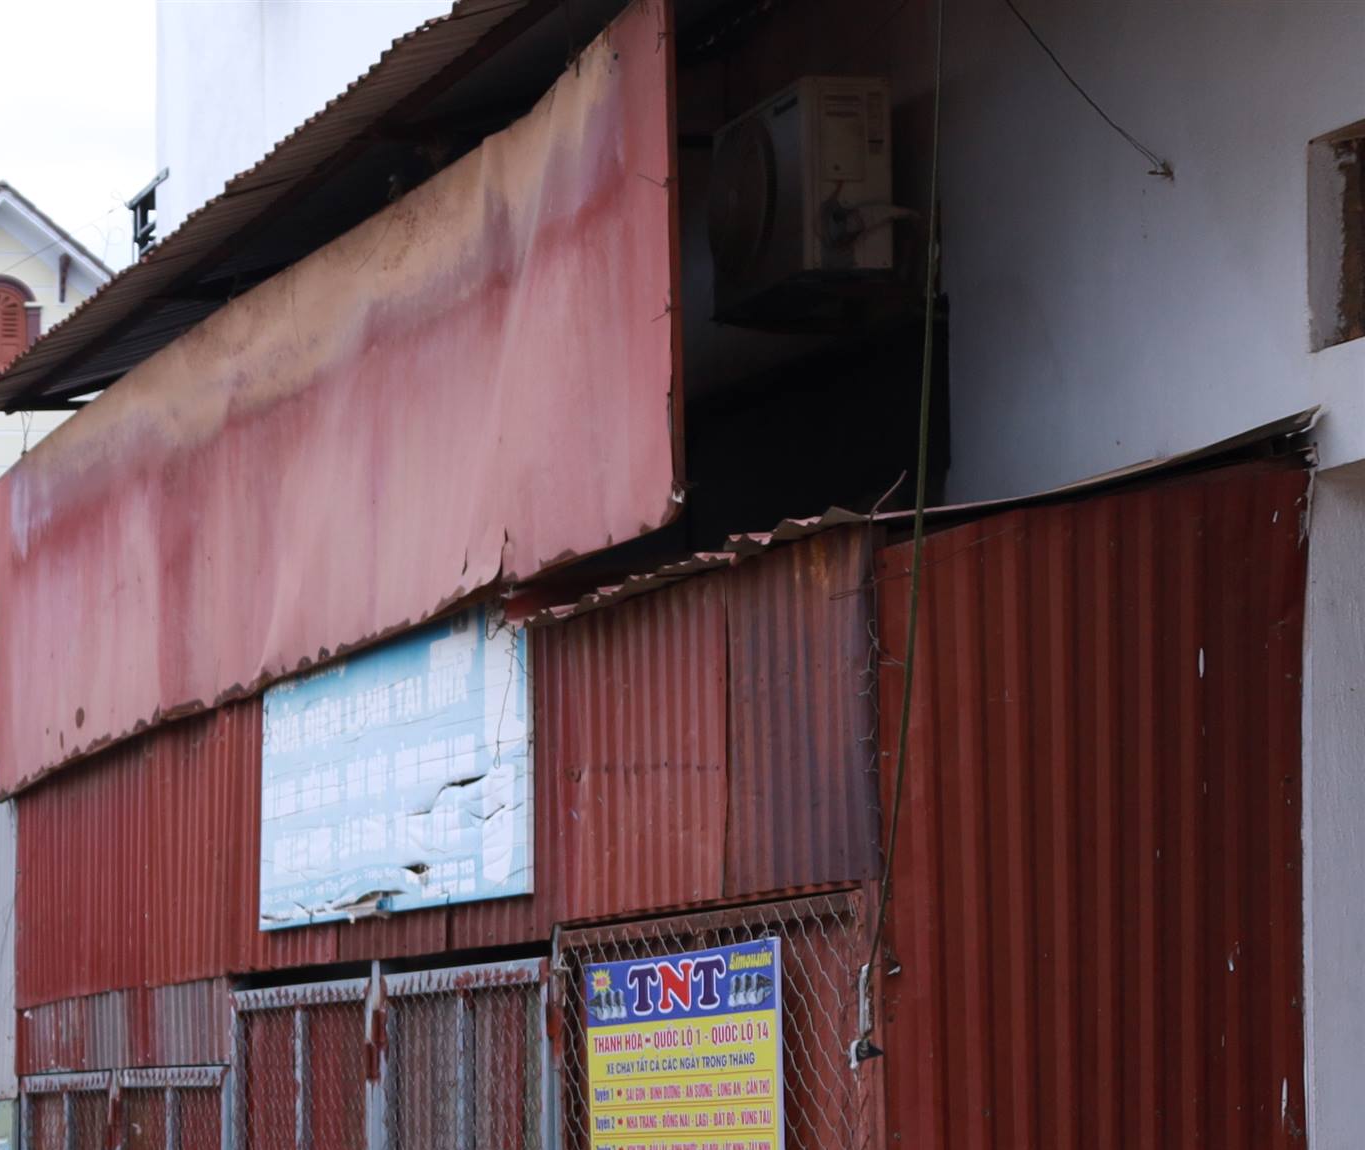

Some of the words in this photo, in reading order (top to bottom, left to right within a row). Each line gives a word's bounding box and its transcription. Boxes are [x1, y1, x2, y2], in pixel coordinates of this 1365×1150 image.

[628, 955, 726, 1016] TNT
[594, 1034, 622, 1054] THANH
[625, 1029, 643, 1051] HÓA
[654, 1022, 679, 1050] QUỐC
[681, 1026, 693, 1050] LỘ
[696, 1029, 701, 1046] 1
[711, 1017, 738, 1046] QUỐC
[741, 1018, 754, 1045] LỘ
[757, 1021, 769, 1040] 14
[607, 1062, 616, 1075] XE
[616, 1061, 635, 1077] CHẠY
[636, 1055, 649, 1073] TẤT
[650, 1054, 660, 1072] CẢ
[661, 1053, 678, 1072] CÁC
[679, 1052, 701, 1069] NGÀY
[729, 1049, 755, 1066] THÁNG
[639, 1114, 657, 1129] TRANG
